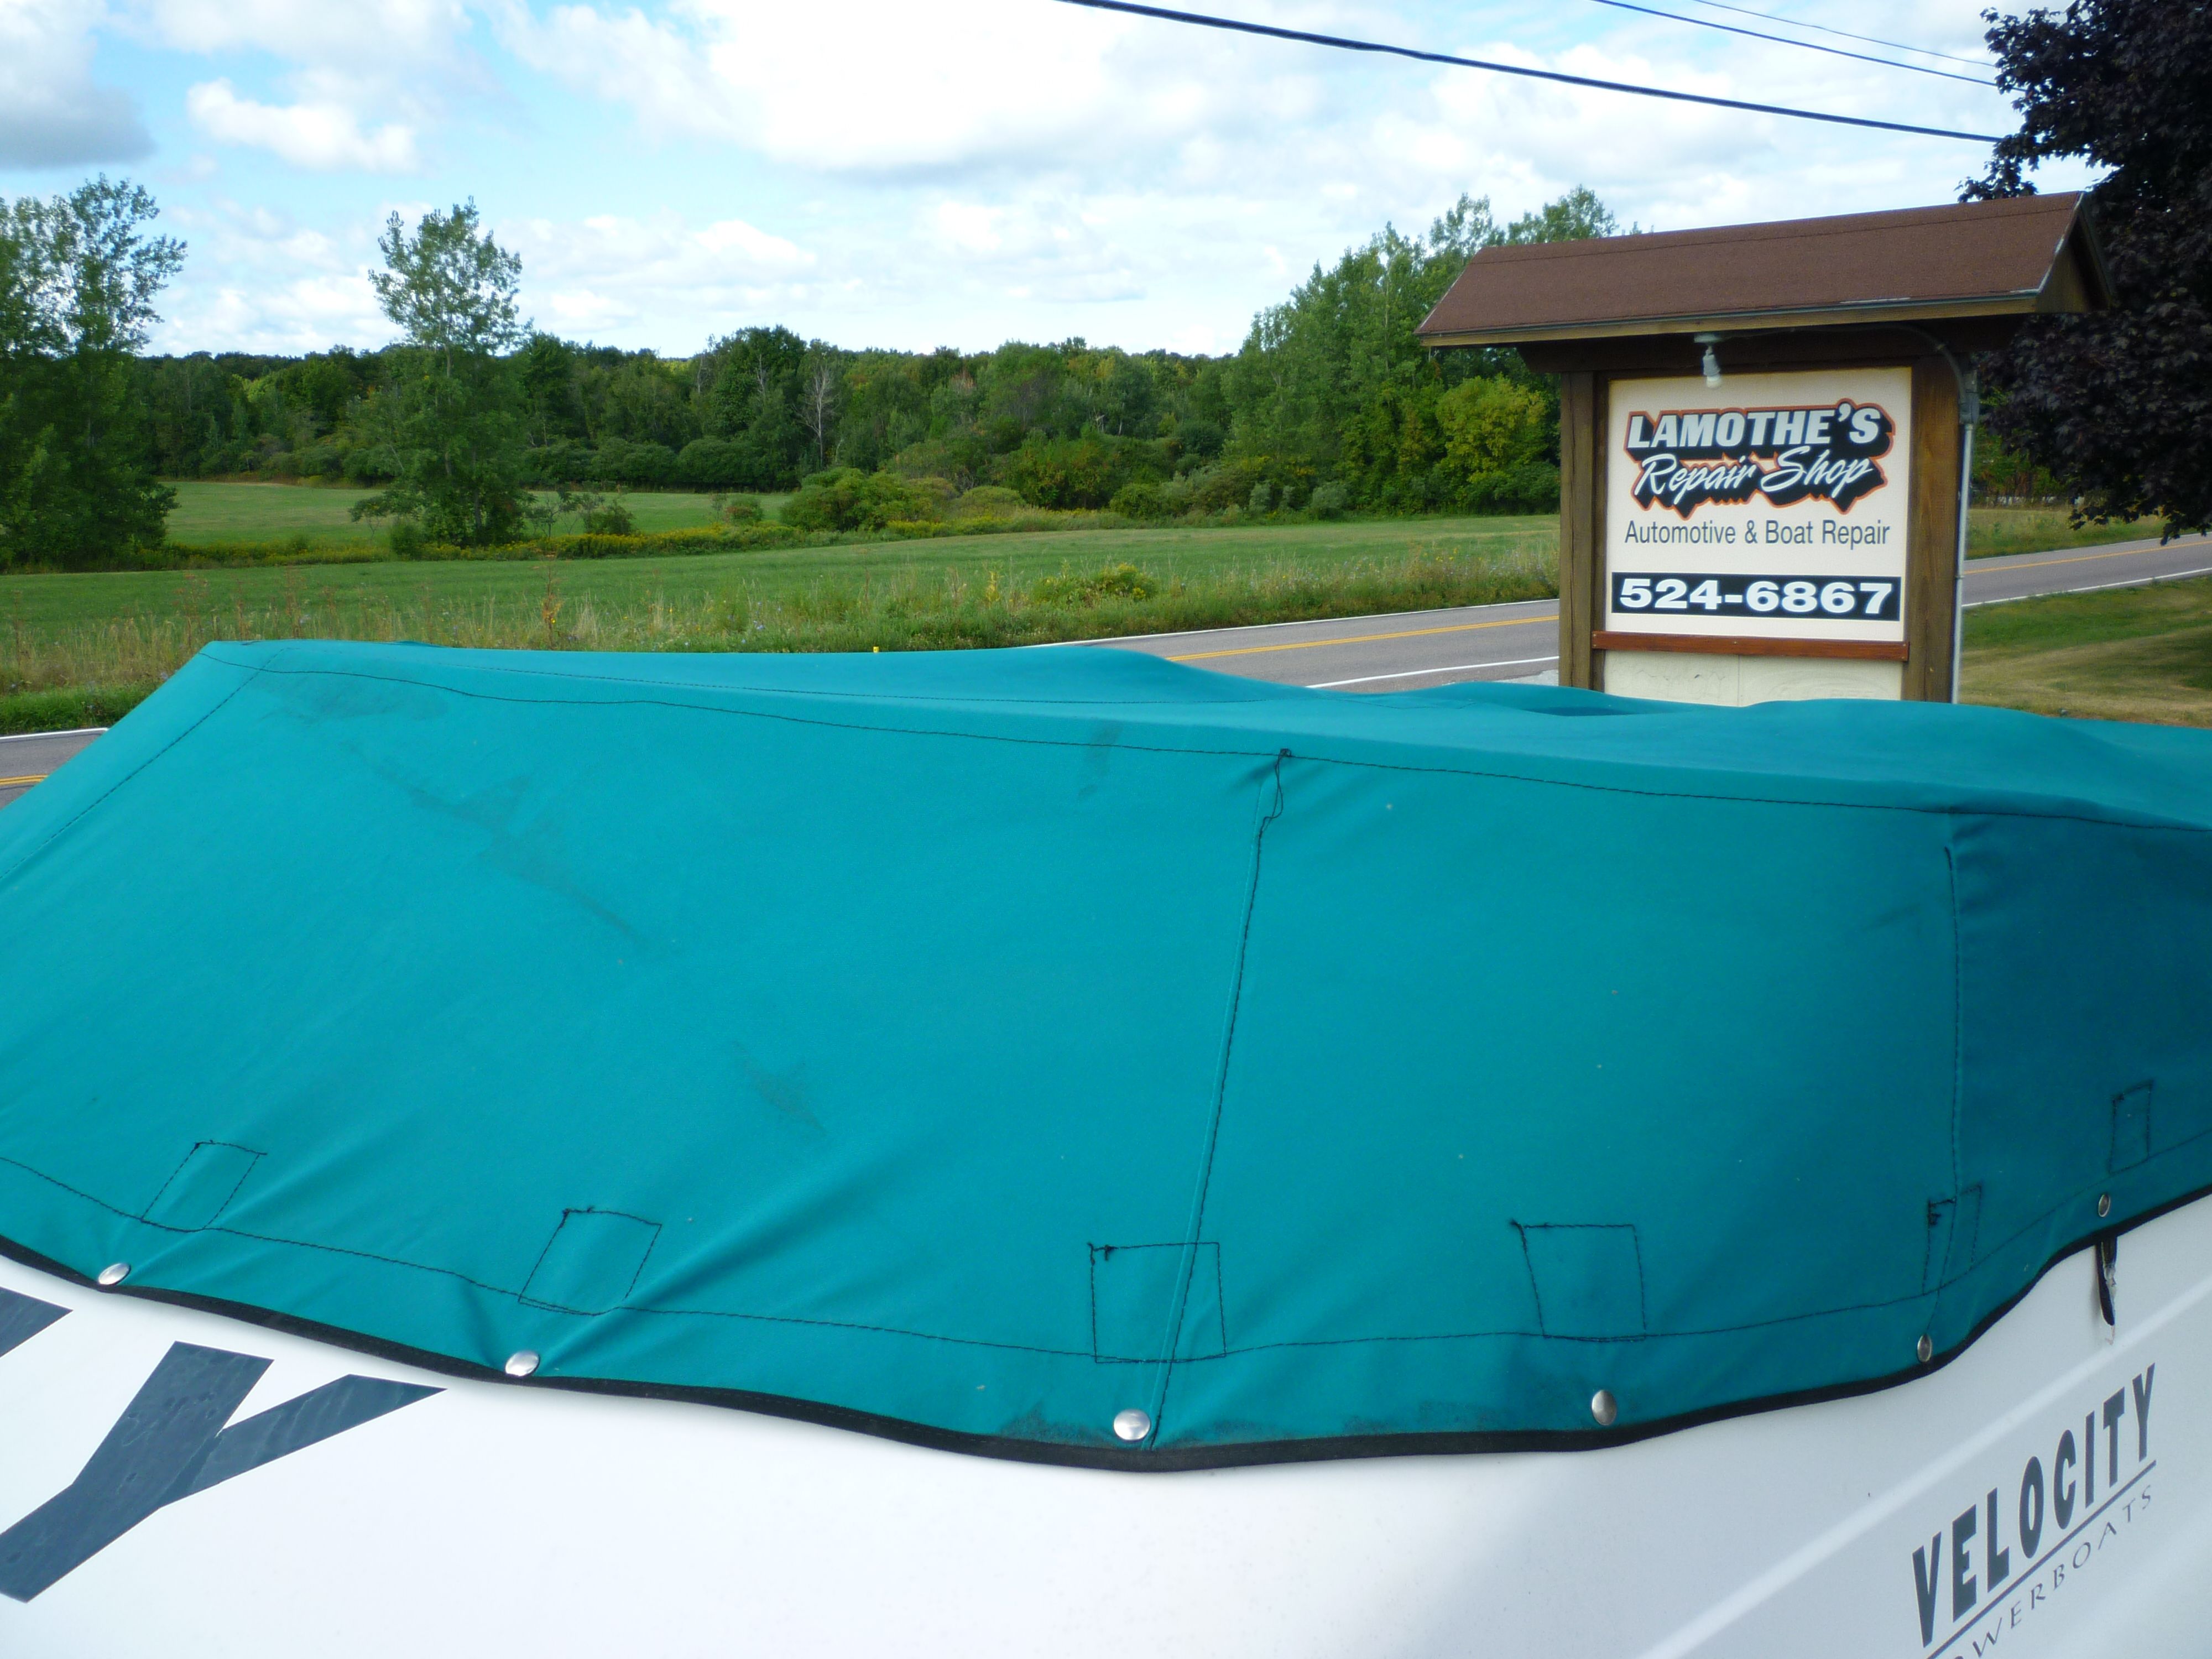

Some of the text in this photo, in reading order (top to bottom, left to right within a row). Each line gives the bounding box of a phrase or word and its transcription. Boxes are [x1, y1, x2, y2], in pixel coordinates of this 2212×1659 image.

[1627, 403, 1881, 448] LAMOTHE'S
[1634, 445, 1875, 505] Repair Shop
[1624, 520, 1891, 550] Automotive & Boat Repair
[1619, 578, 1892, 614] 524-6867
[1912, 1362, 2156, 1648] VELOCITY
[1952, 1484, 2152, 1659] WERBOATS
